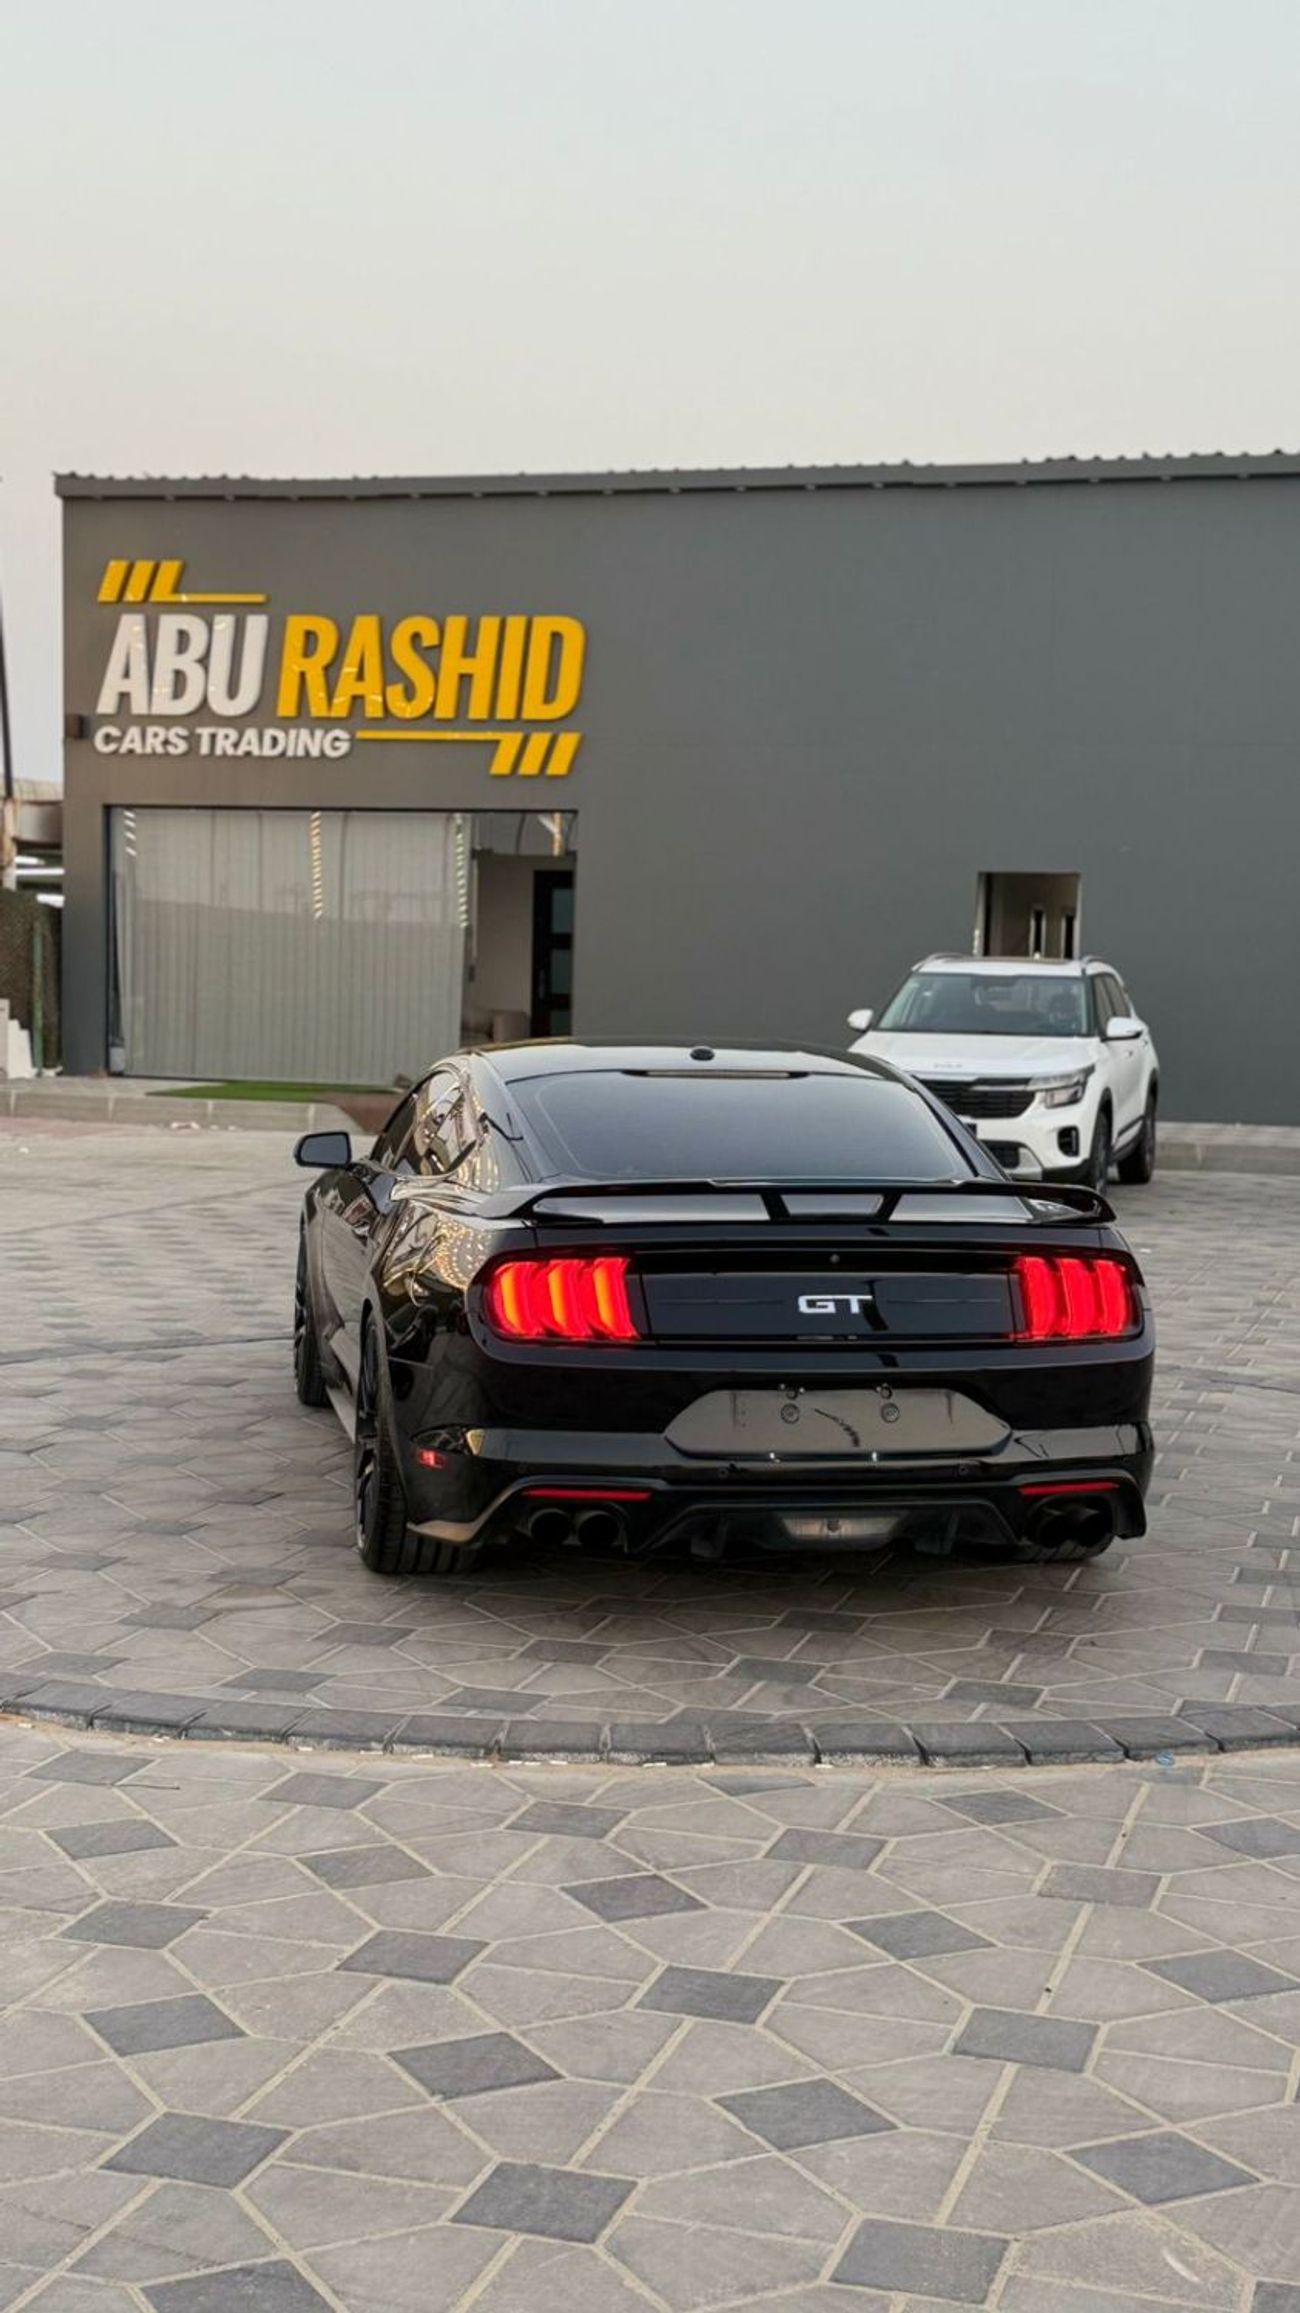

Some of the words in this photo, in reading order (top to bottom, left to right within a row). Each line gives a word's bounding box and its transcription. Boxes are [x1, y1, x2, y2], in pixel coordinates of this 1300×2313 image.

[96, 613, 269, 717] ABU
[277, 614, 586, 720] RASHID
[94, 725, 188, 755] CARS
[197, 727, 351, 758] TRADING
[798, 1294, 873, 1314] GT
